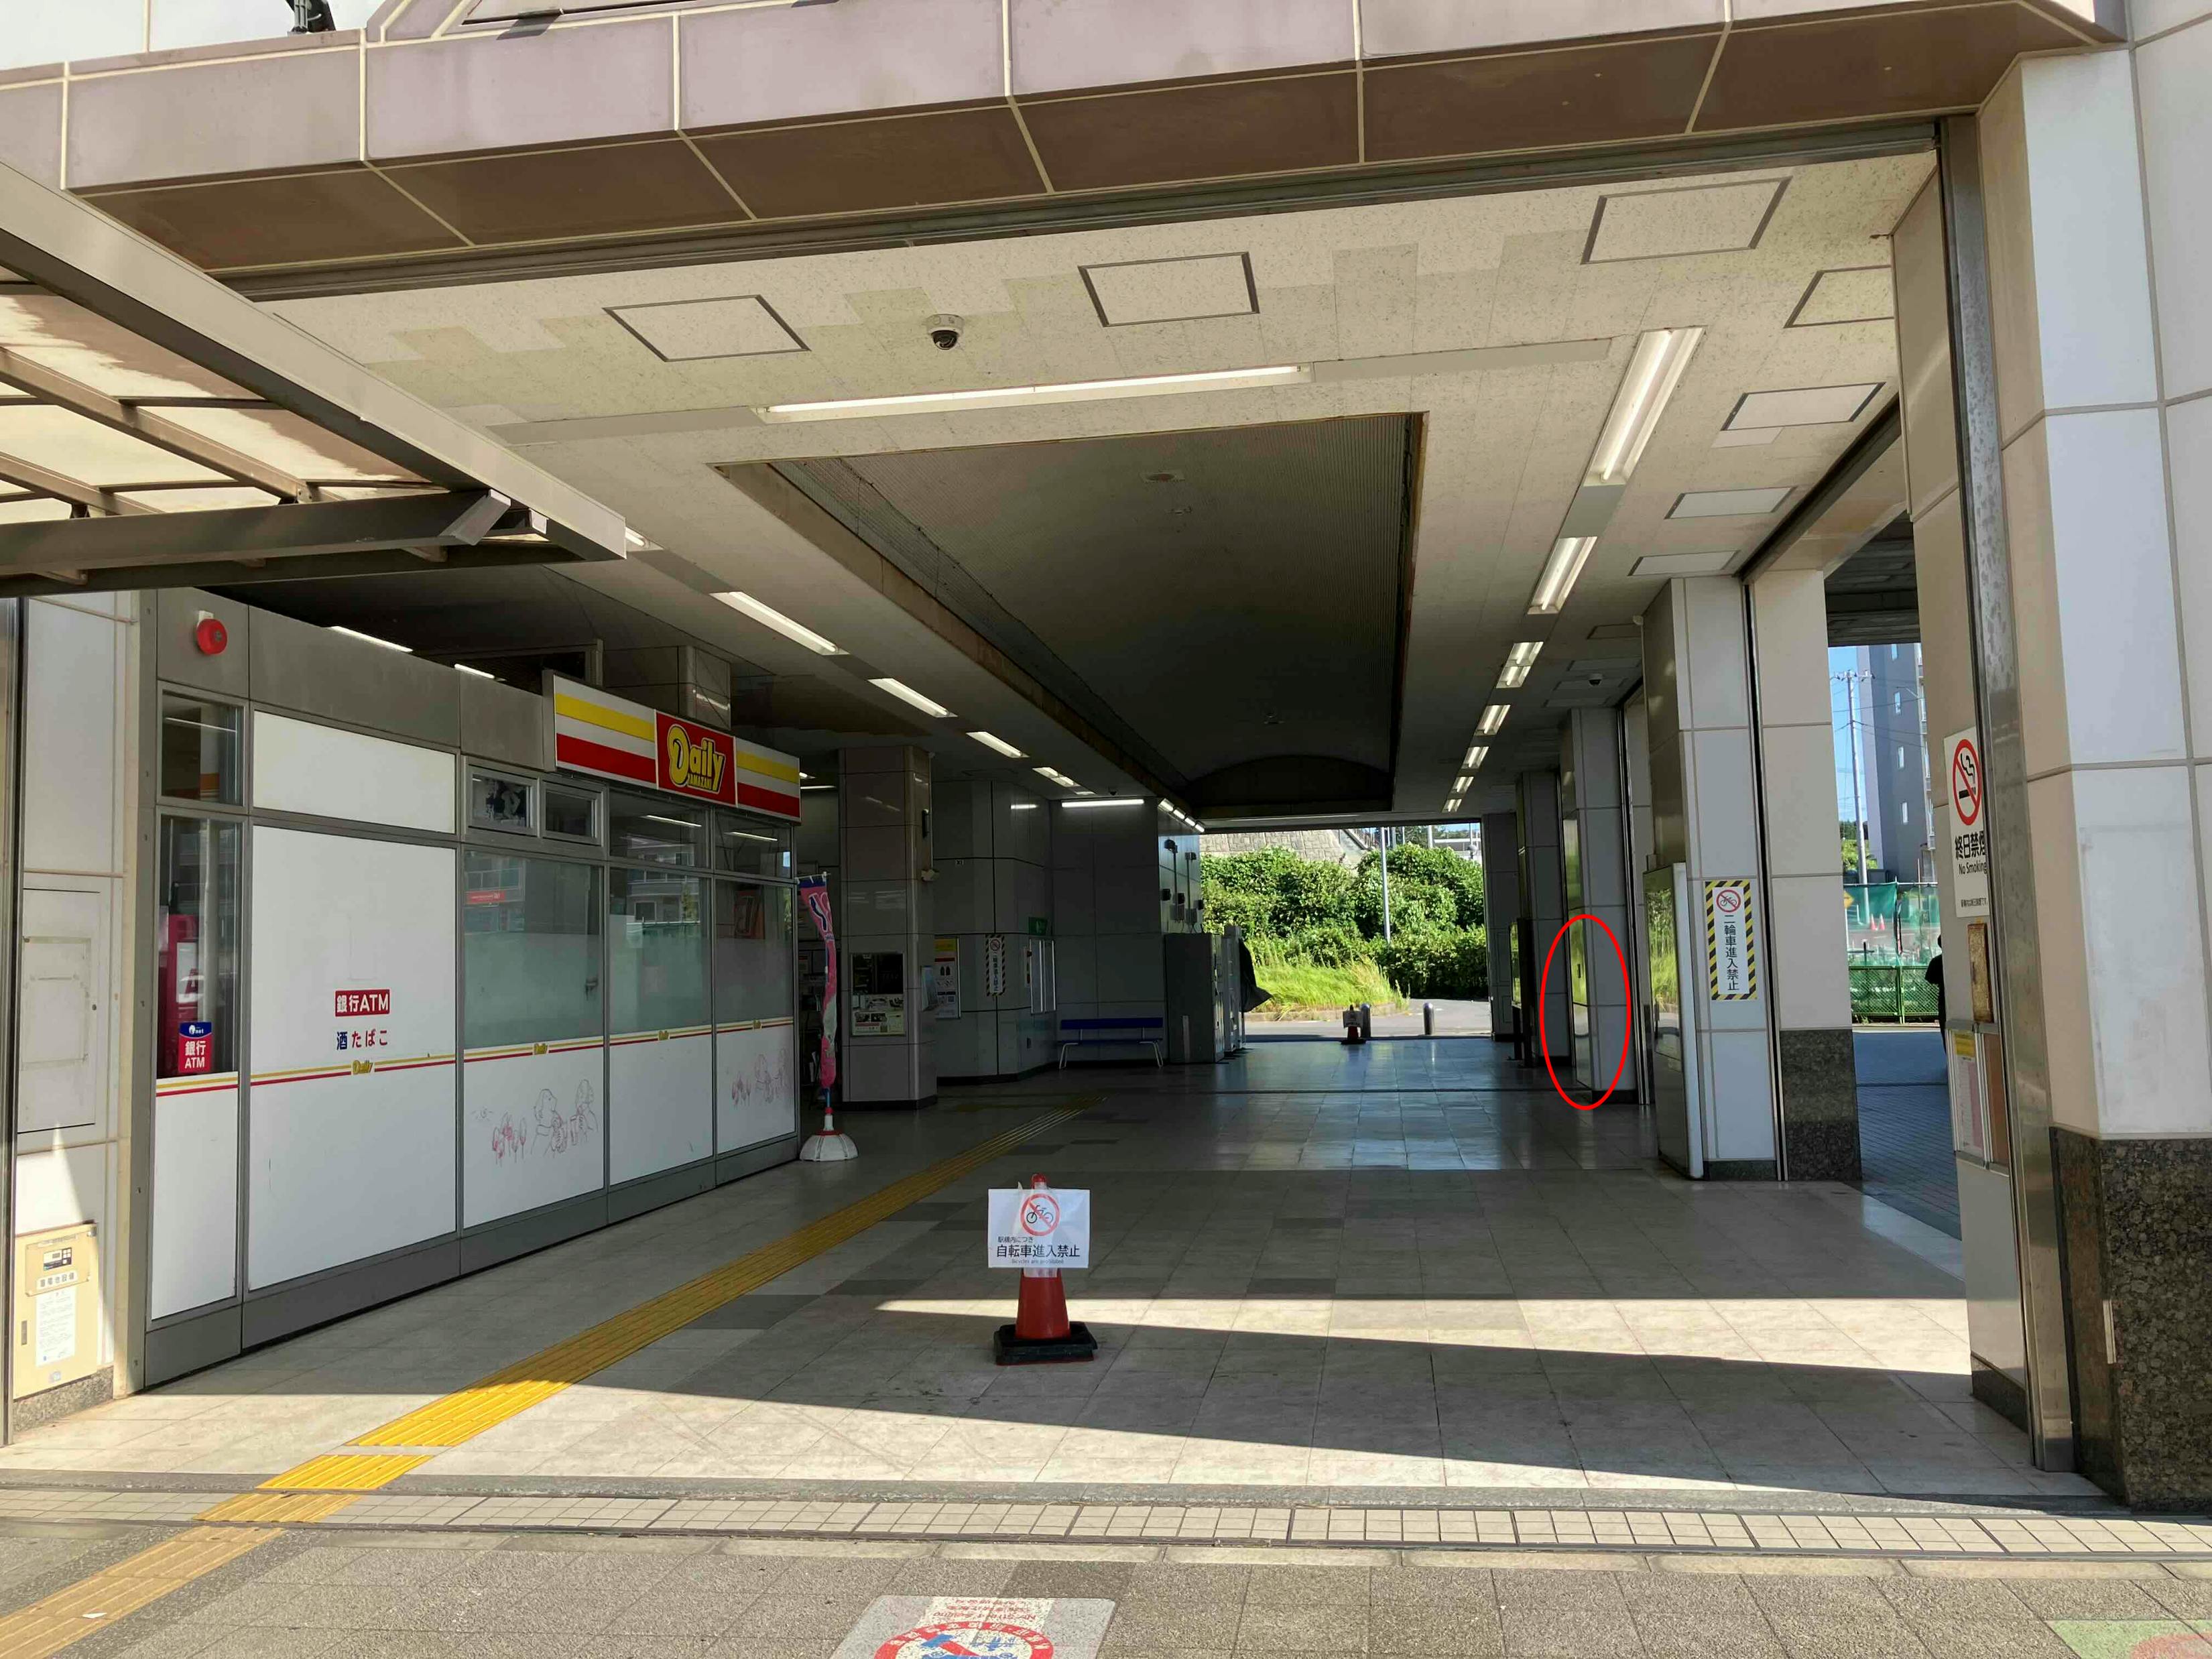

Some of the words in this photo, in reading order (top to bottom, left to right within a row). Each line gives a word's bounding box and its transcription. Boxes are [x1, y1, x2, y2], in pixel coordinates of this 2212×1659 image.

[668, 725, 725, 793] Daily
[1959, 863, 1966, 875] No
[1967, 860, 1987, 874] Smoking
[1724, 914, 1739, 991] 二輪車進入禁止
[336, 994, 389, 1013] 銀行ATM
[185, 1040, 206, 1056] 銀行
[184, 1056, 205, 1069] ATM
[997, 1244, 1081, 1257] 自転車進入禁止
